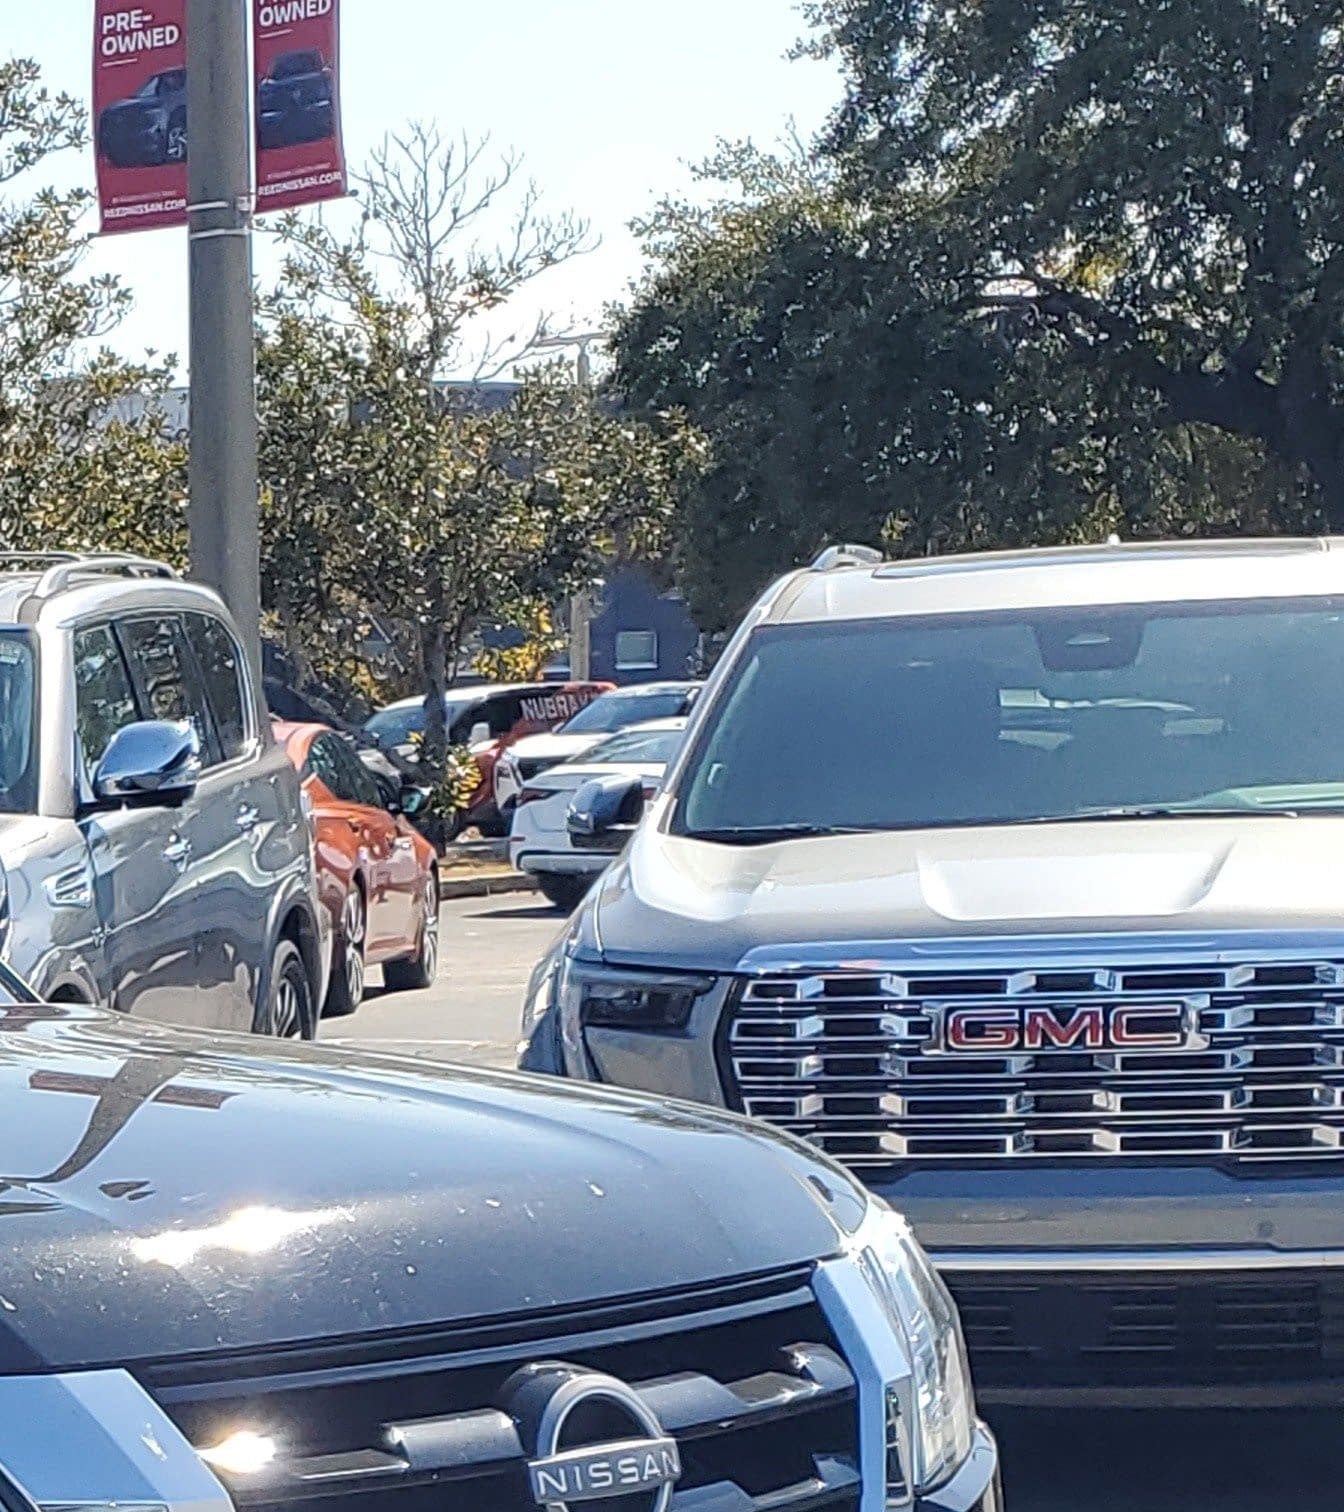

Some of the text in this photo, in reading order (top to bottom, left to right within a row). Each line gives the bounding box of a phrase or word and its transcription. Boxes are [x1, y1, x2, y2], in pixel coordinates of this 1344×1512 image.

[102, 9, 153, 35] PRE-
[259, 0, 332, 27] OWNED
[101, 25, 180, 56] OWNED
[519, 689, 598, 721] NUBRA
[946, 1003, 1184, 1049] GMC
[536, 1451, 681, 1495] NISSAN
